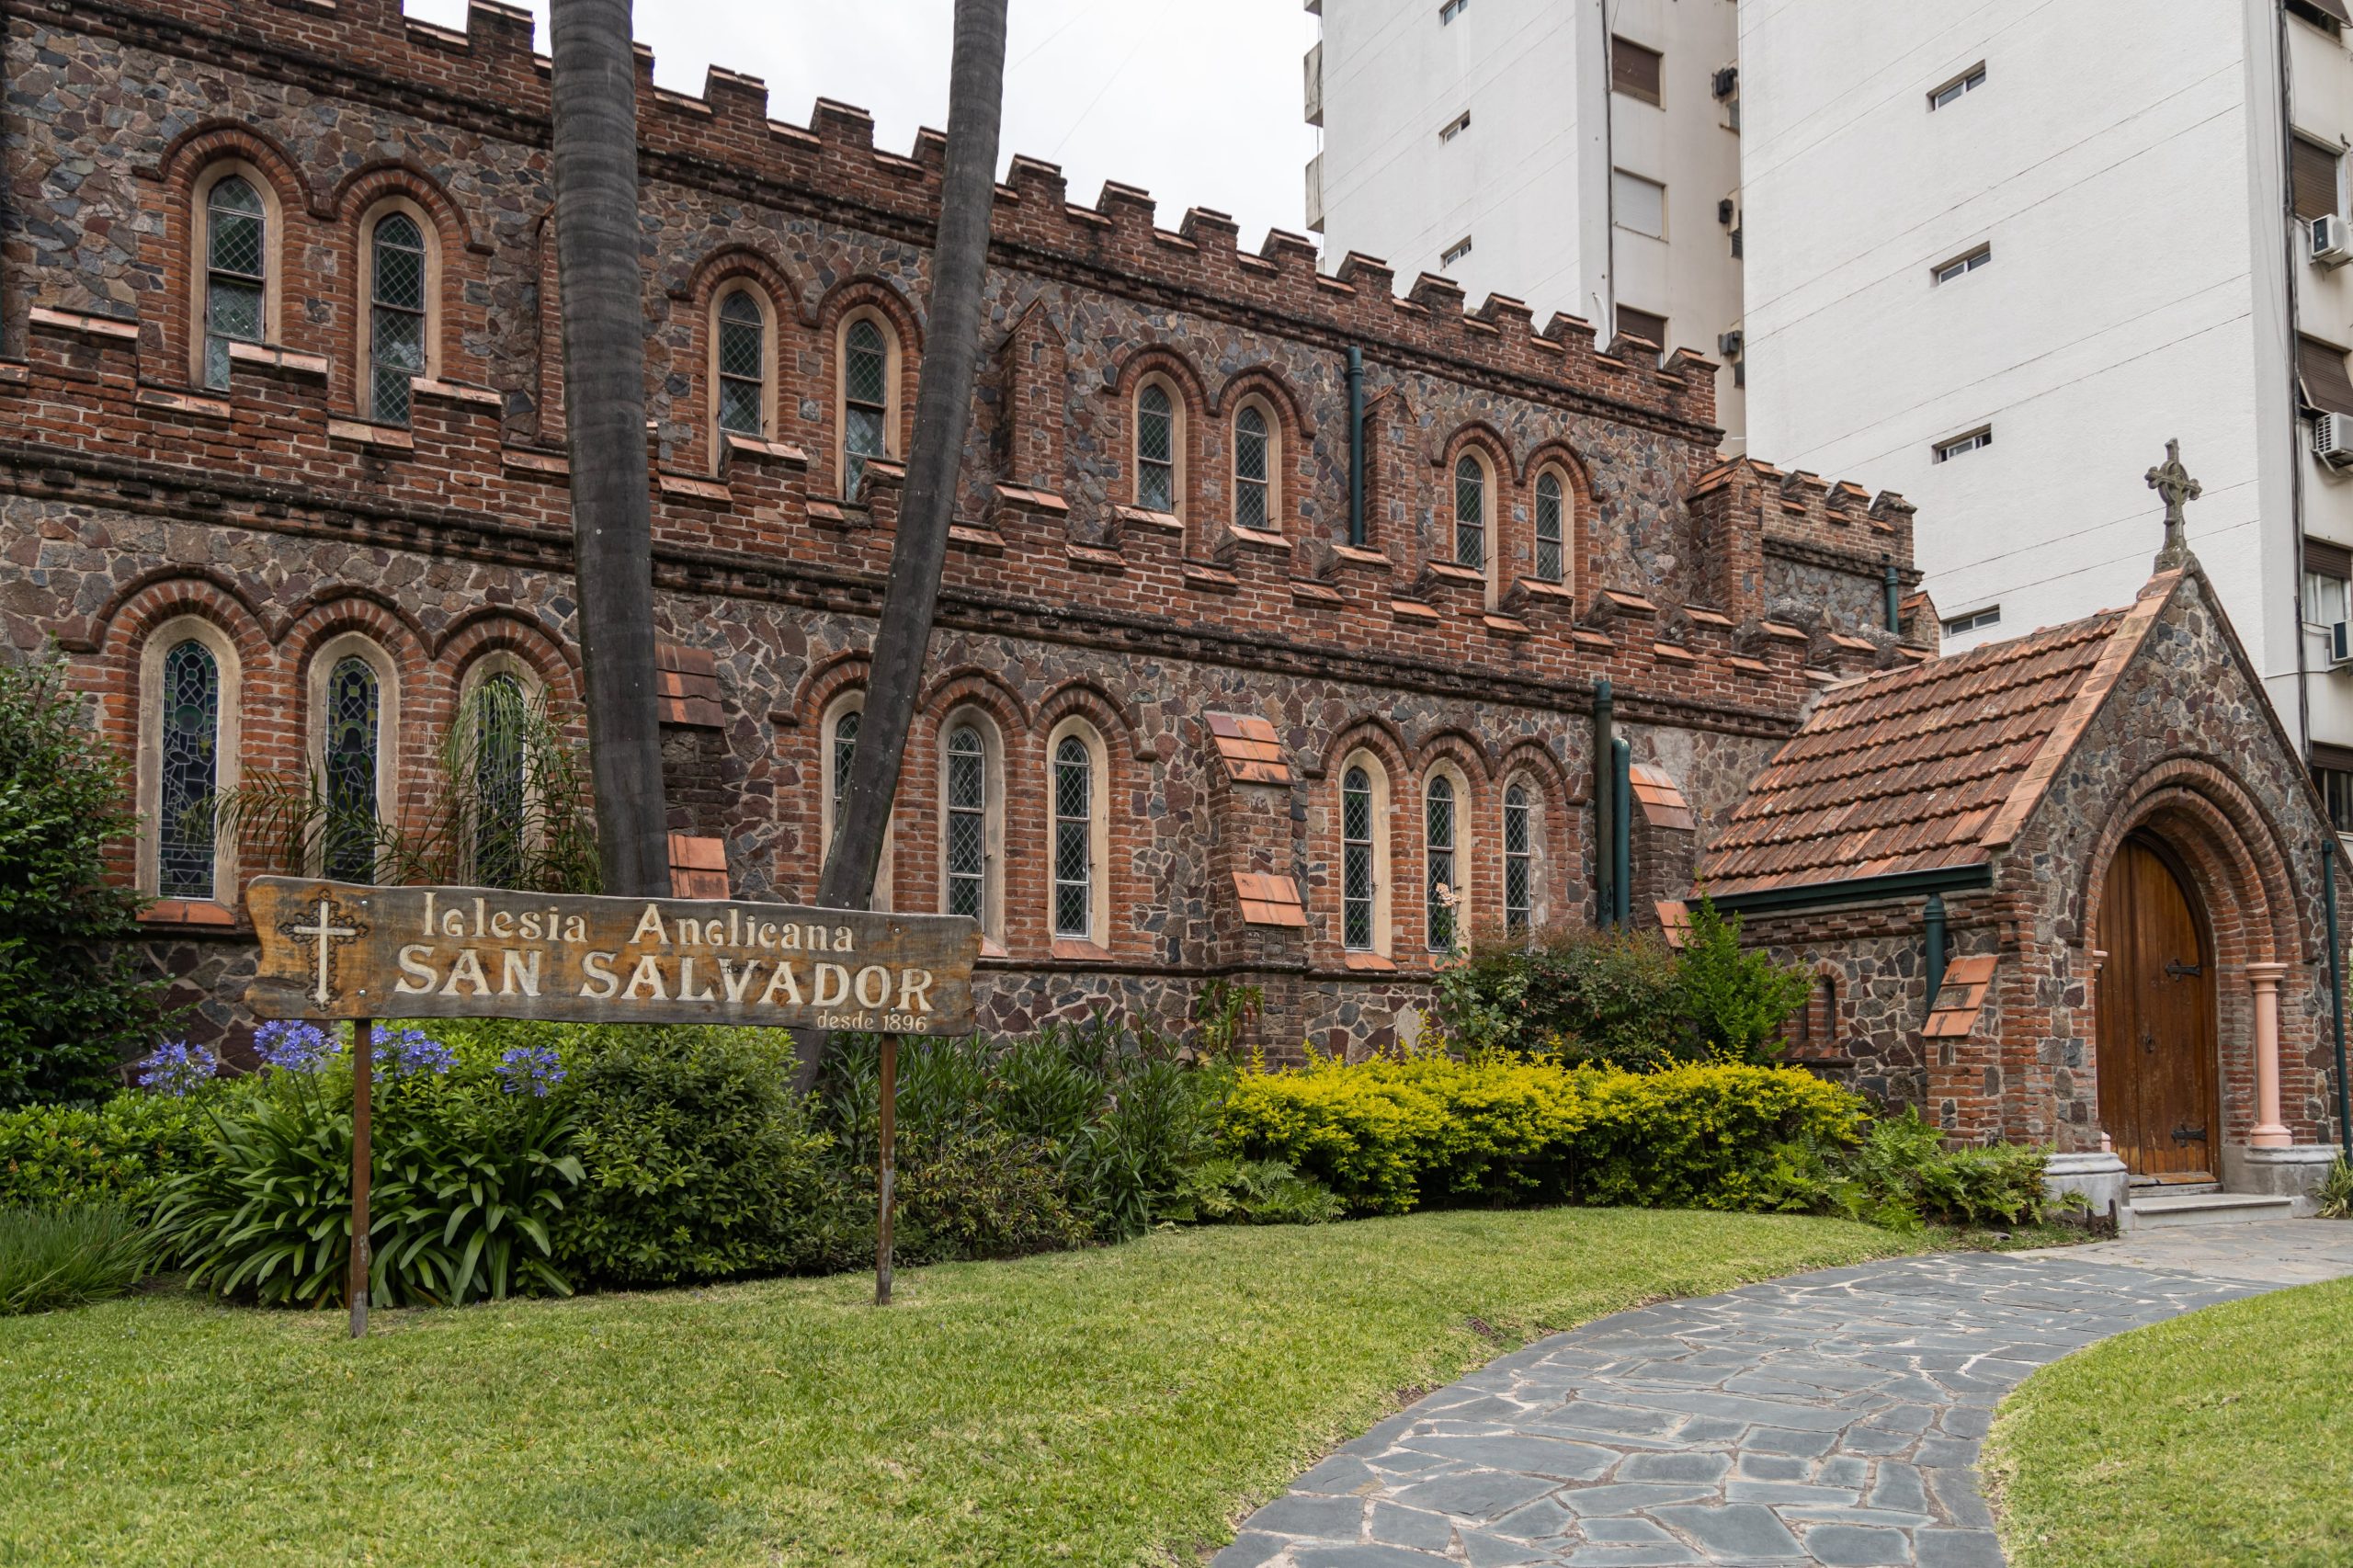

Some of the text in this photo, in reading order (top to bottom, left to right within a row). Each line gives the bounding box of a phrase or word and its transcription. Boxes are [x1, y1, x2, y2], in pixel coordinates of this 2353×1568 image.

[394, 944, 935, 1012] SAN SALVADOR
[817, 1011, 928, 1032] desde 1896
